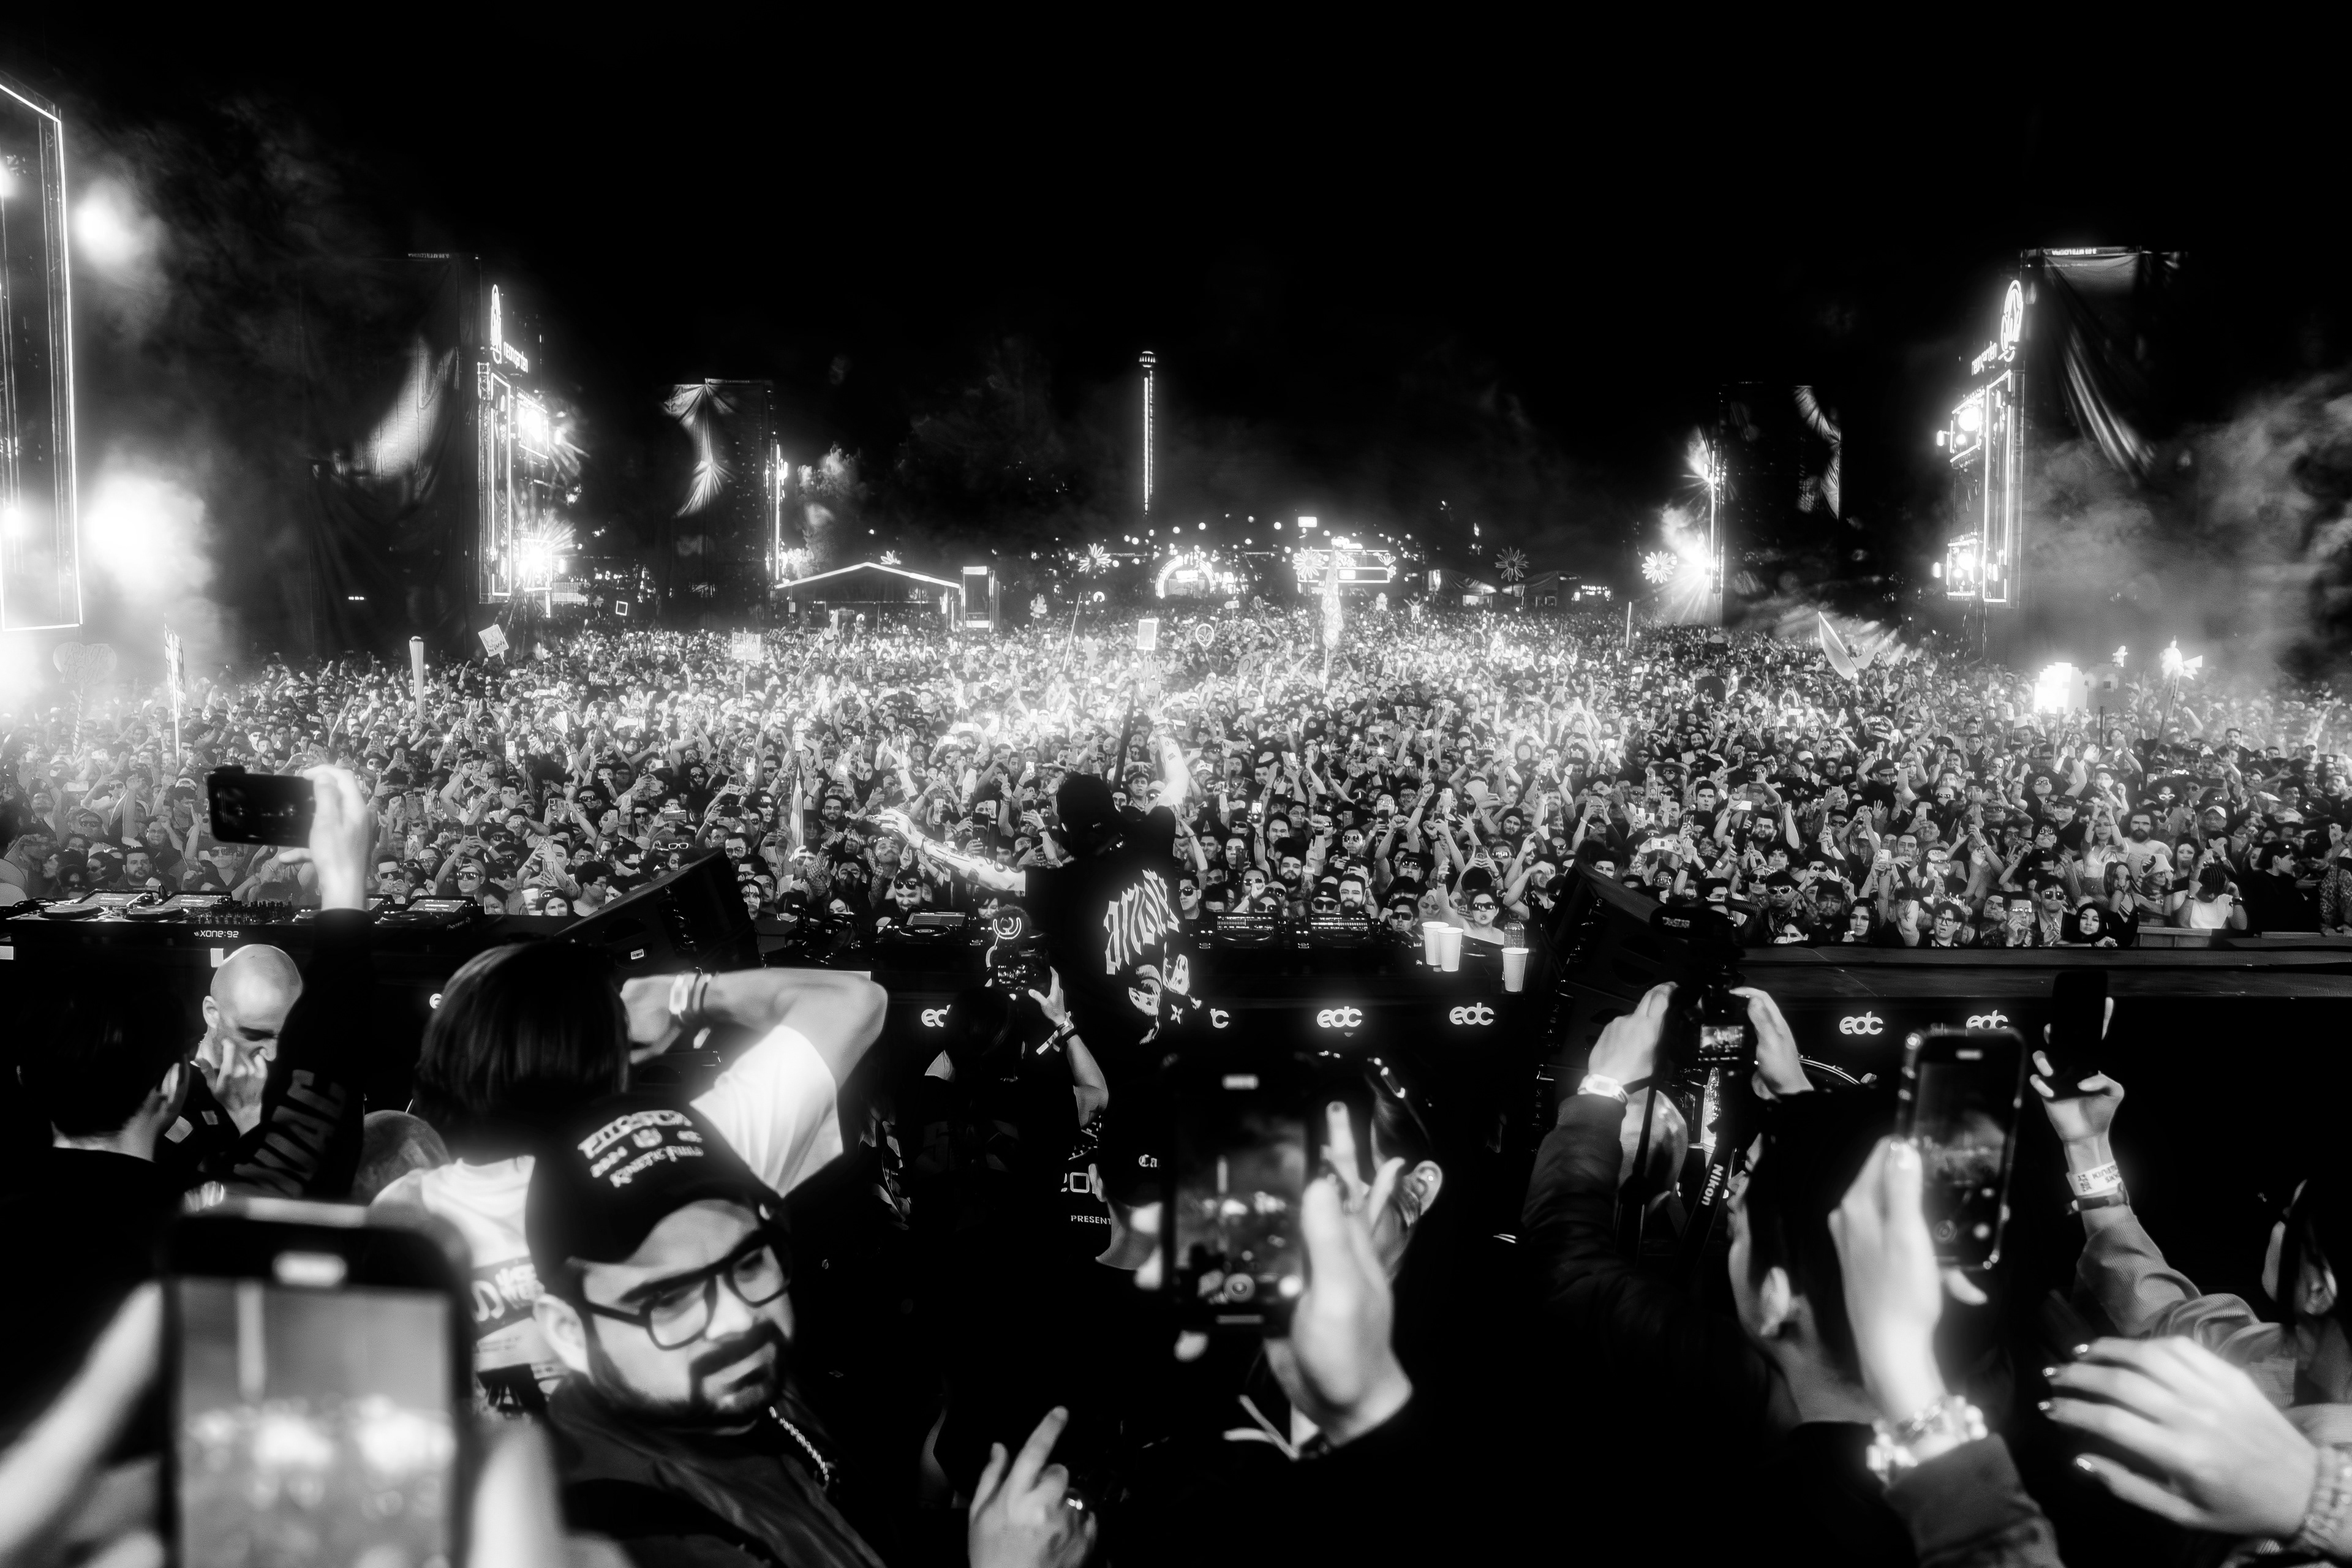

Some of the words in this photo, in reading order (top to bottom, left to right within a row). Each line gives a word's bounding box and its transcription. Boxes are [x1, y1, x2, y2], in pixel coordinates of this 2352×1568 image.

[1317, 1006, 1362, 1027] edc
[1449, 1003, 1494, 1025] edc
[1839, 1011, 1883, 1035] edc
